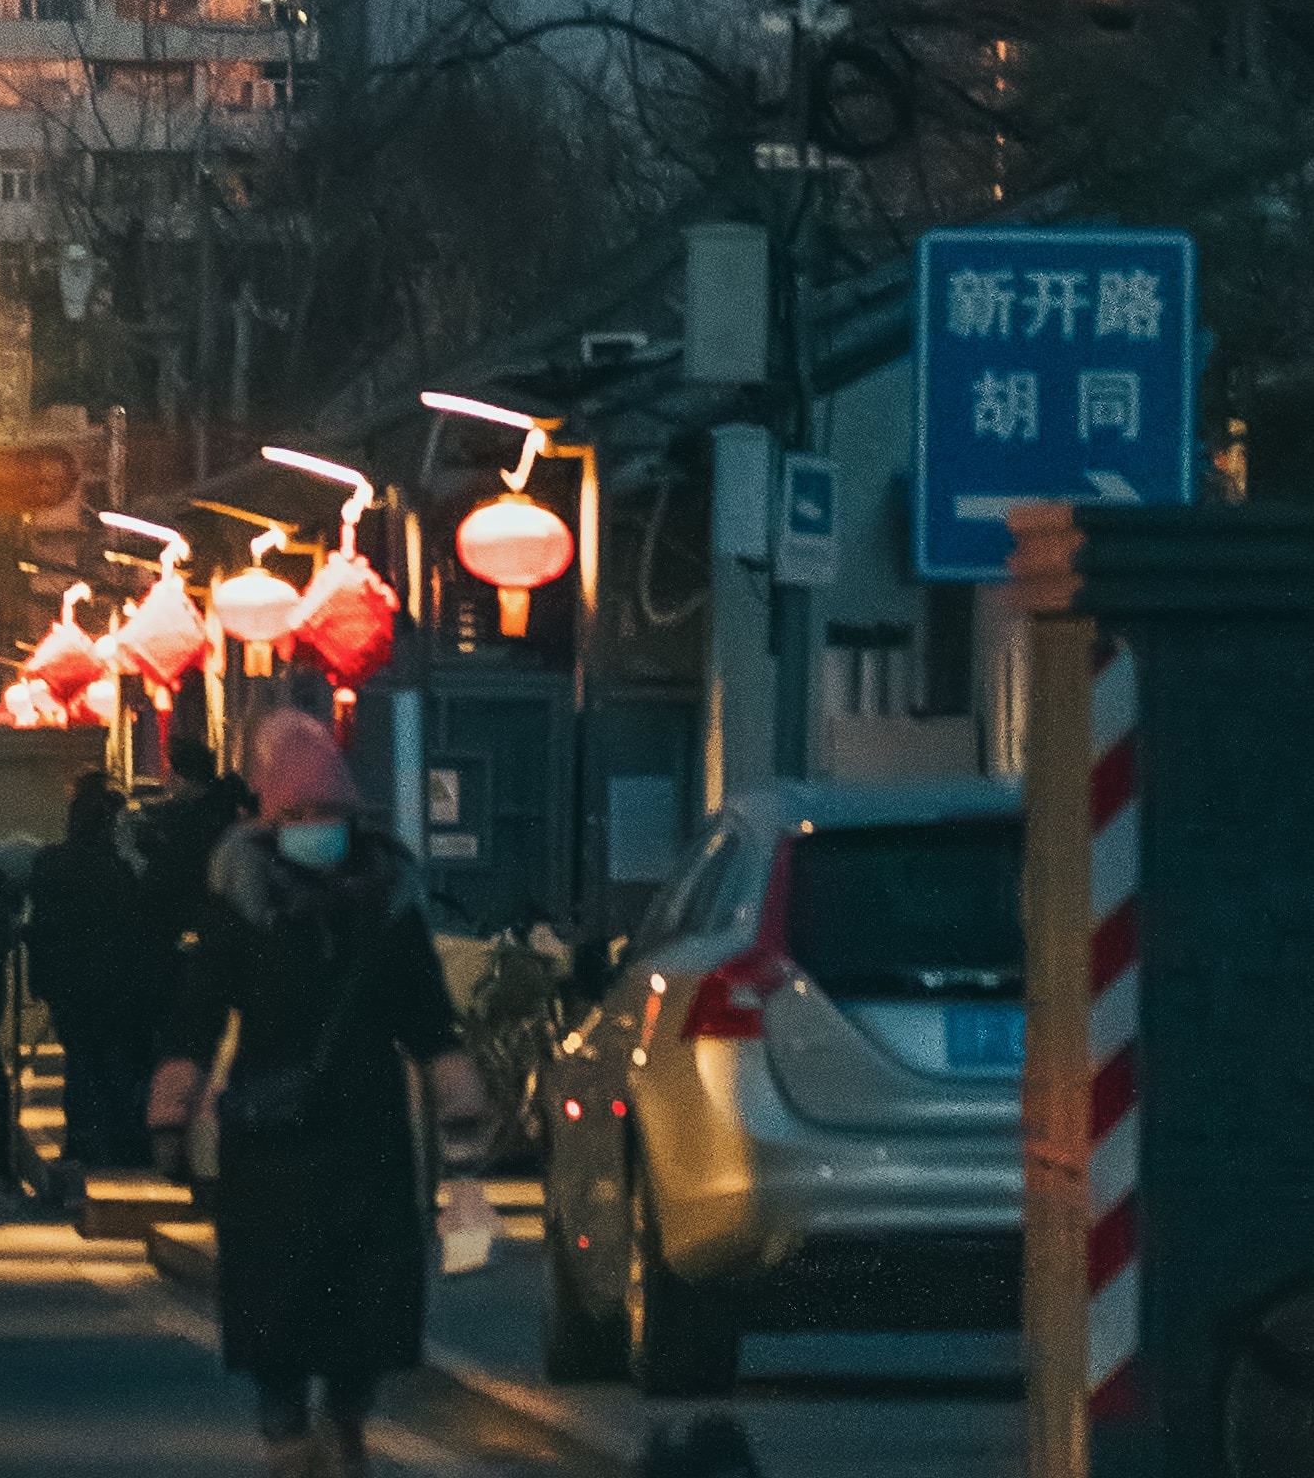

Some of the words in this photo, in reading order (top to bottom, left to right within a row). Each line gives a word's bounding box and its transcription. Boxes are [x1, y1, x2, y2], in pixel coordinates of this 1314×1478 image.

[947, 269, 1163, 338] 新开路
[974, 371, 1141, 442] 胡同
